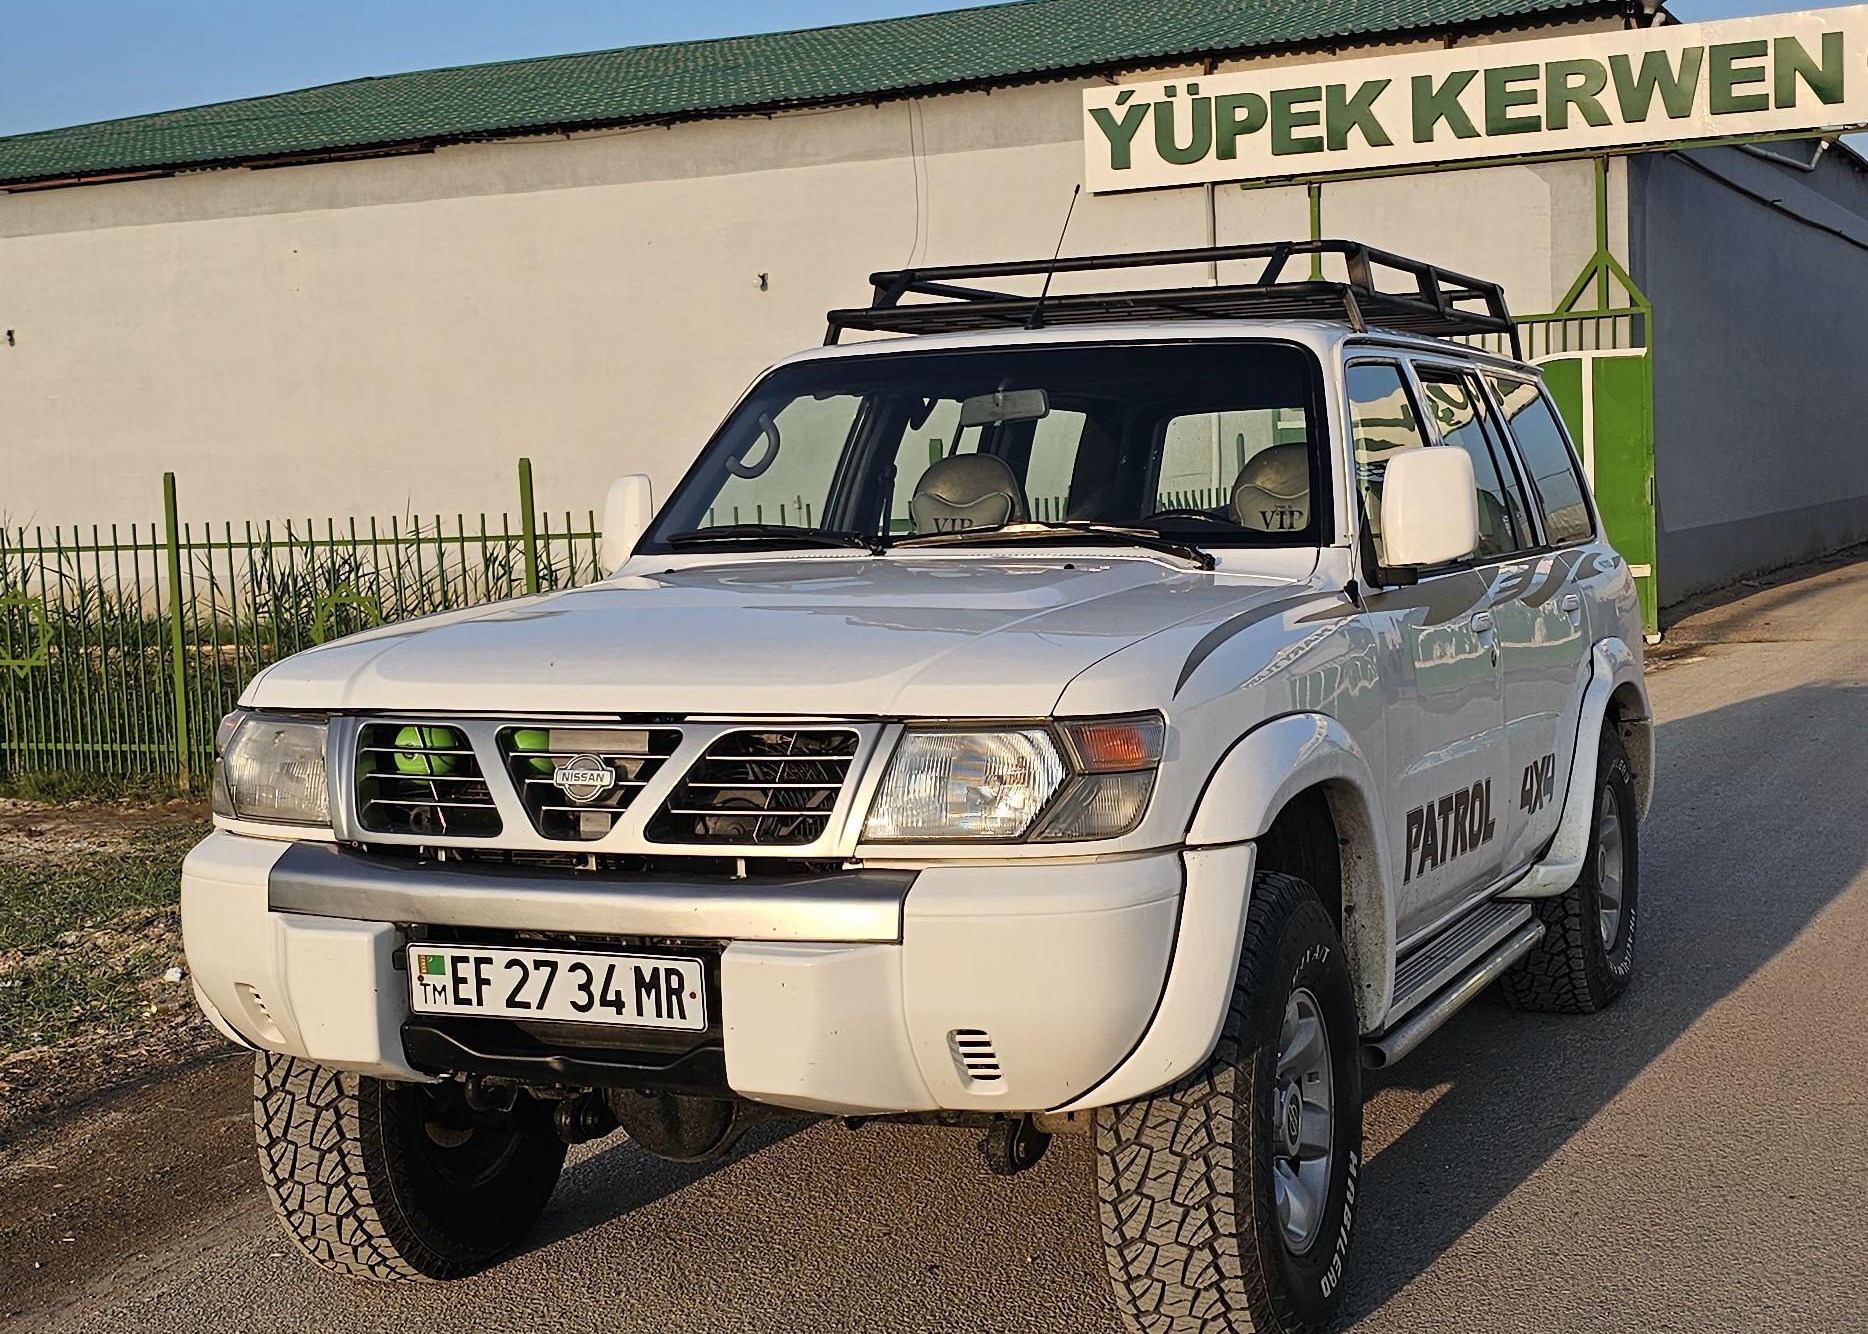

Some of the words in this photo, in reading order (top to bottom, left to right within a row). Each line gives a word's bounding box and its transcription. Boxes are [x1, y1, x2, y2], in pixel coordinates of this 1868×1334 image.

[1088, 78, 1393, 170] ÝÜPEK
[1411, 31, 1844, 144] KERWEN
[1259, 509, 1304, 530] VIP
[561, 771, 605, 783] NISSAN
[1403, 777, 1496, 886] PATROL
[1520, 753, 1556, 815] 4X4
[420, 982, 448, 1006] TM
[450, 955, 493, 1007] EF
[633, 965, 687, 1021] MR
[1320, 1150, 1358, 1298] HABILEAD
